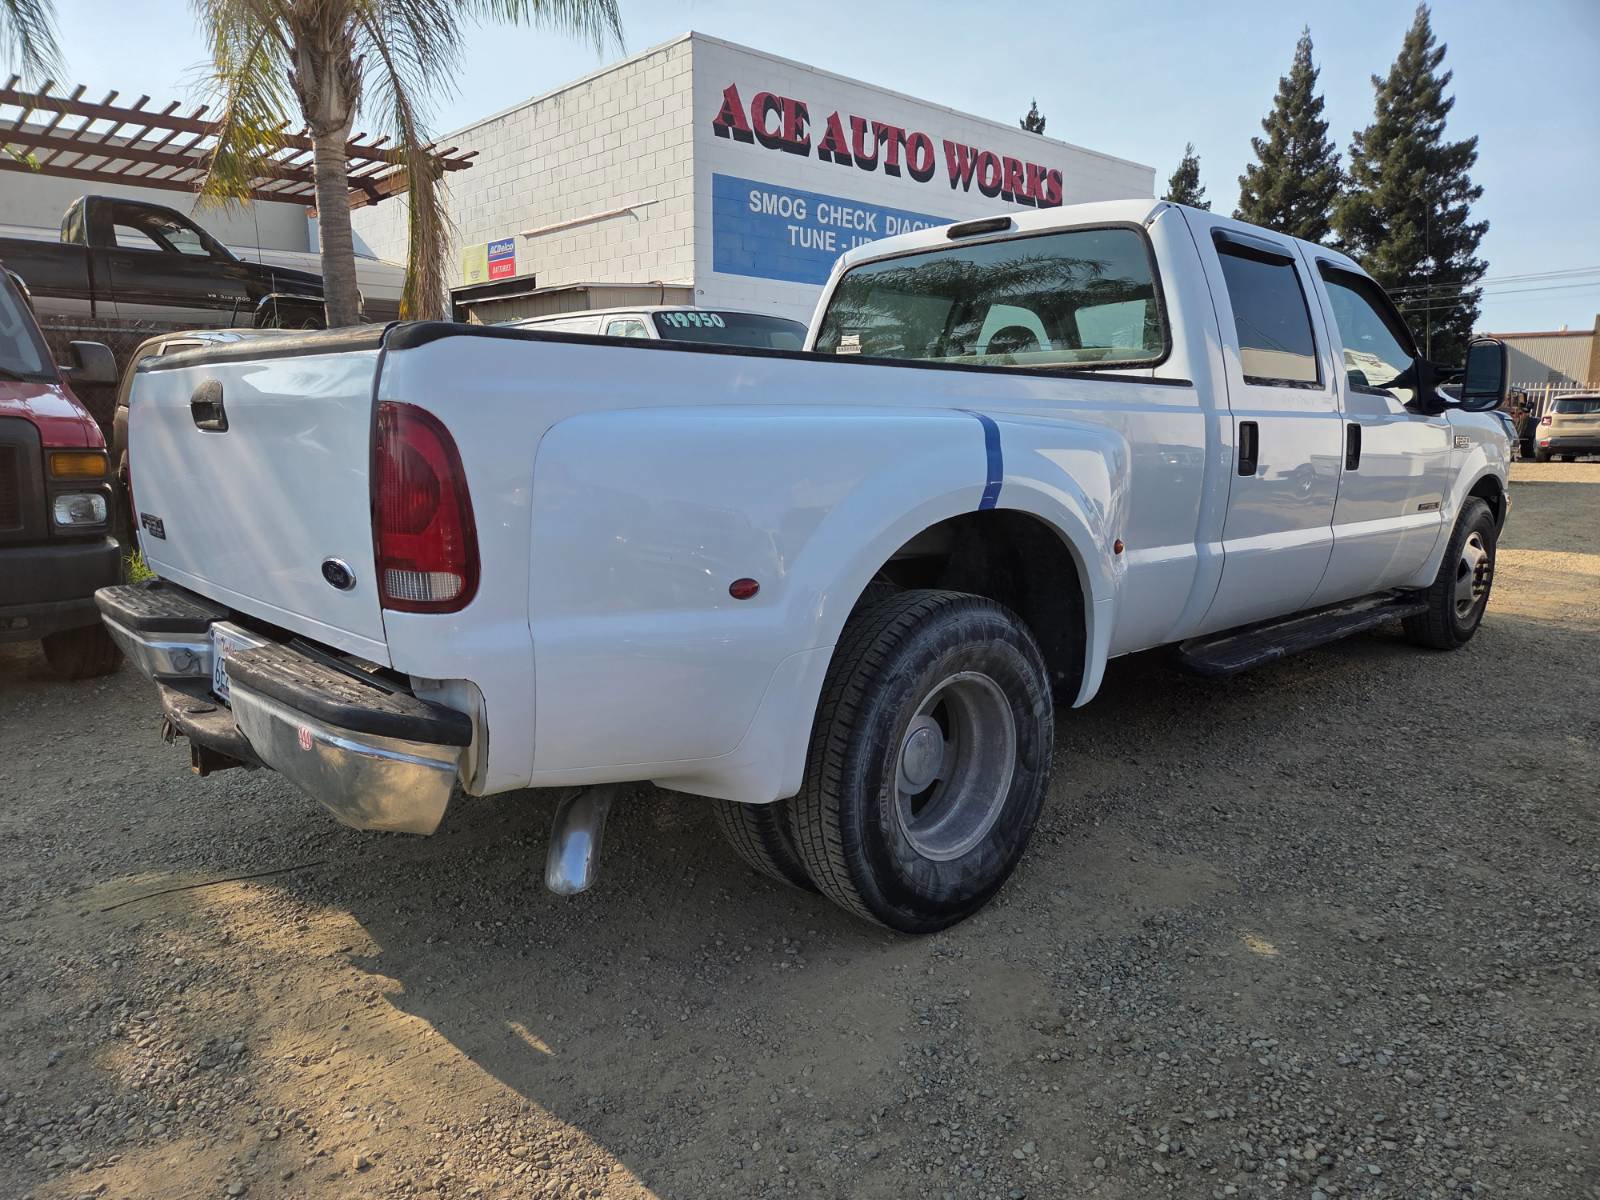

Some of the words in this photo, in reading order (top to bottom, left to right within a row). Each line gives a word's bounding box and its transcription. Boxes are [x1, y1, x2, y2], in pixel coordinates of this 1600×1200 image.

[712, 82, 811, 157] ACE
[818, 110, 935, 183] AUTO
[943, 139, 1064, 208] WORKS
[749, 190, 807, 220] SMOG
[817, 203, 877, 233] CHECK
[787, 225, 836, 252] TUNE
[661, 312, 726, 328] $19950
